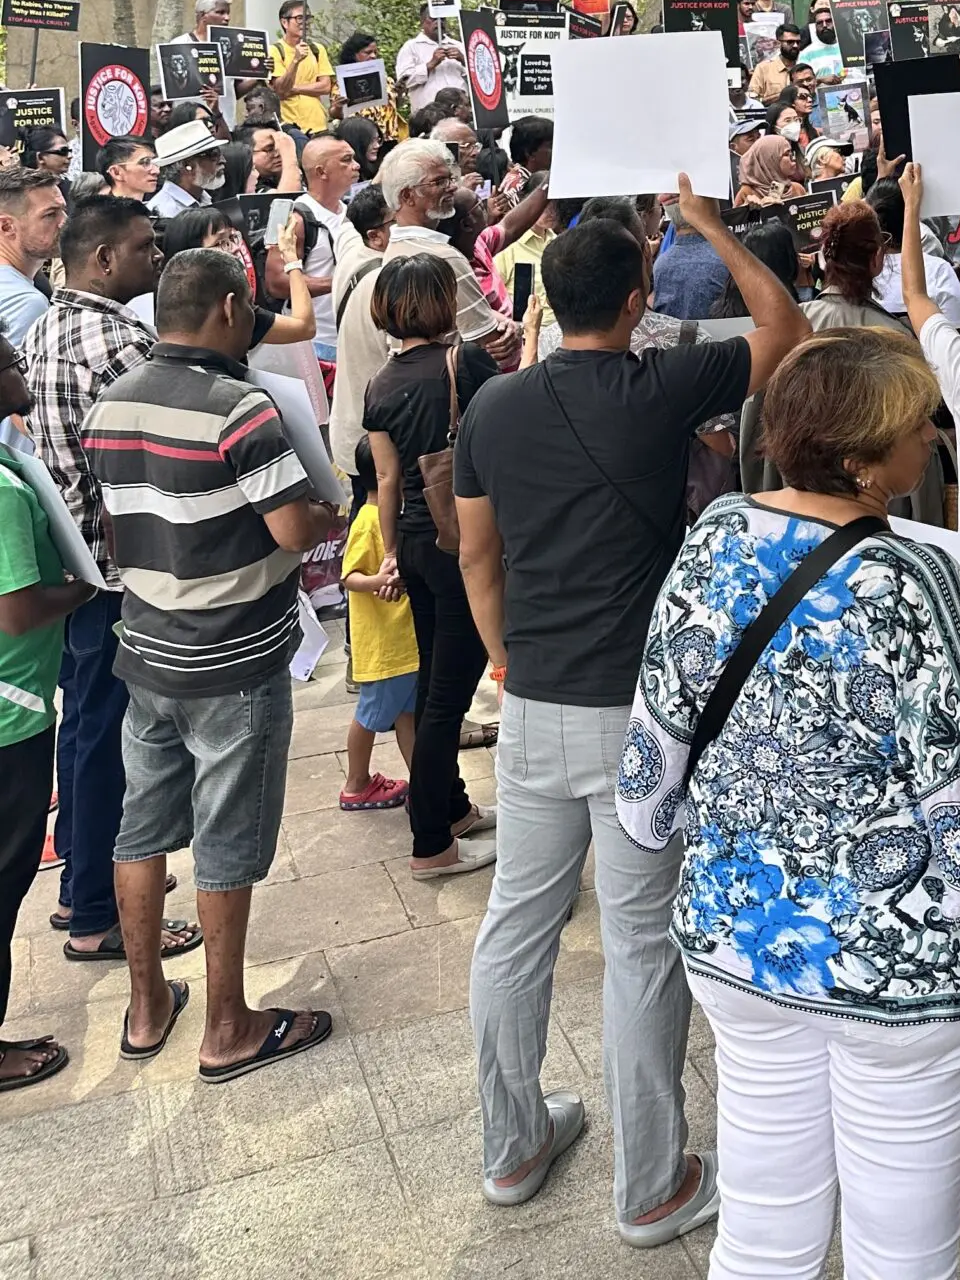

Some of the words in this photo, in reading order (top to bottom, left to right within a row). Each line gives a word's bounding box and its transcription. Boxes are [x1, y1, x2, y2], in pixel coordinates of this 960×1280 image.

[54, 3, 73, 11] Threat
[895, 16, 919, 24] JUSTICE
[500, 30, 527, 39] JUSTICE
[529, 30, 543, 39] FOR
[544, 31, 561, 39] KOPI
[242, 42, 264, 50] JUSTICE
[87, 68, 113, 111] JUSTICE
[114, 67, 134, 84] FOR
[132, 81, 146, 114] KOPI
[15, 106, 53, 117] JUSTICE
[14, 119, 32, 128] FOR
[33, 117, 55, 126] KOPI
[796, 222, 812, 231] FOR
